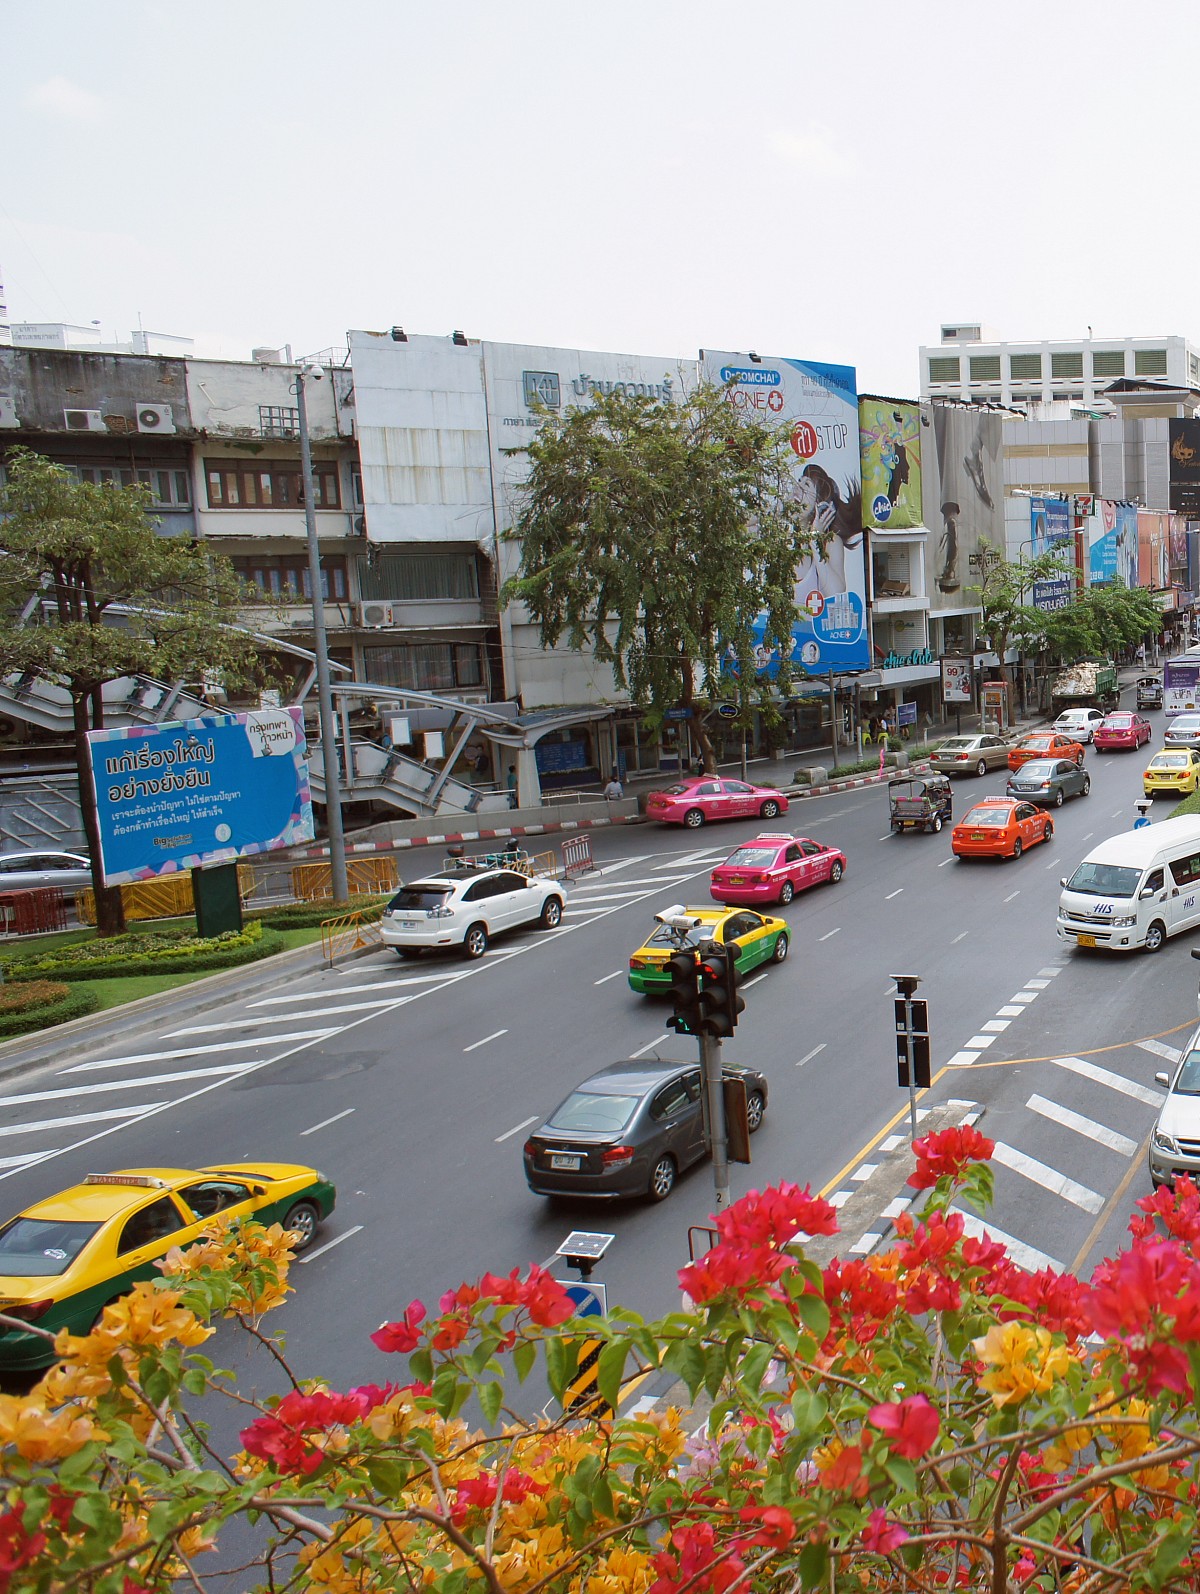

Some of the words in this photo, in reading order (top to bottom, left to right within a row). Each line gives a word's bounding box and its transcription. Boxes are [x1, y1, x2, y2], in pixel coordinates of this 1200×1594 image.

[725, 390, 766, 410] ACNE
[816, 424, 848, 450] STOP
[946, 667, 958, 676] 99
[105, 738, 215, 775] แก้เรื่องใหญ่
[108, 767, 211, 802] อย่างยั่งยืน
[716, 1193, 722, 1203] 2
